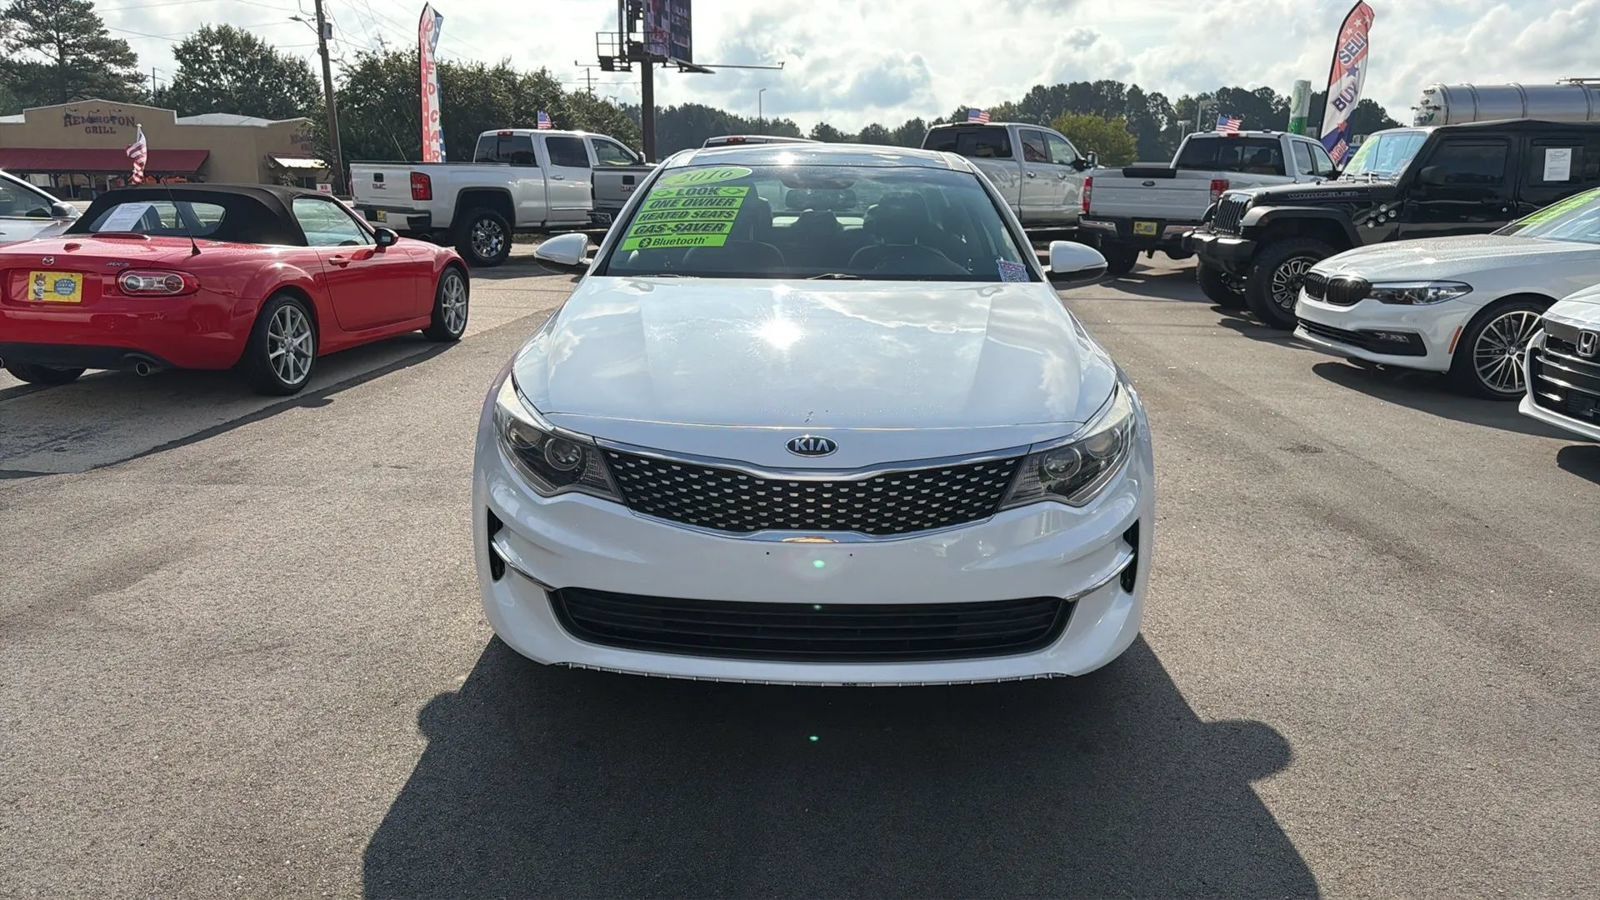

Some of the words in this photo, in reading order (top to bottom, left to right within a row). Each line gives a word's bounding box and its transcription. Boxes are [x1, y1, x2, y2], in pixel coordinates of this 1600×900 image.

[1338, 30, 1367, 65] SELL
[1332, 83, 1358, 112] BUY
[85, 125, 117, 135] GRILL
[674, 169, 733, 184] 2016
[675, 187, 720, 197] LOOK
[650, 199, 677, 208] ONE
[682, 198, 737, 208] OWNER
[640, 211, 690, 221] HEATED
[691, 210, 735, 219] SEATS
[635, 223, 726, 235] GAS-SAVER
[652, 236, 706, 247] Bluetooth
[794, 438, 830, 452] KIA
